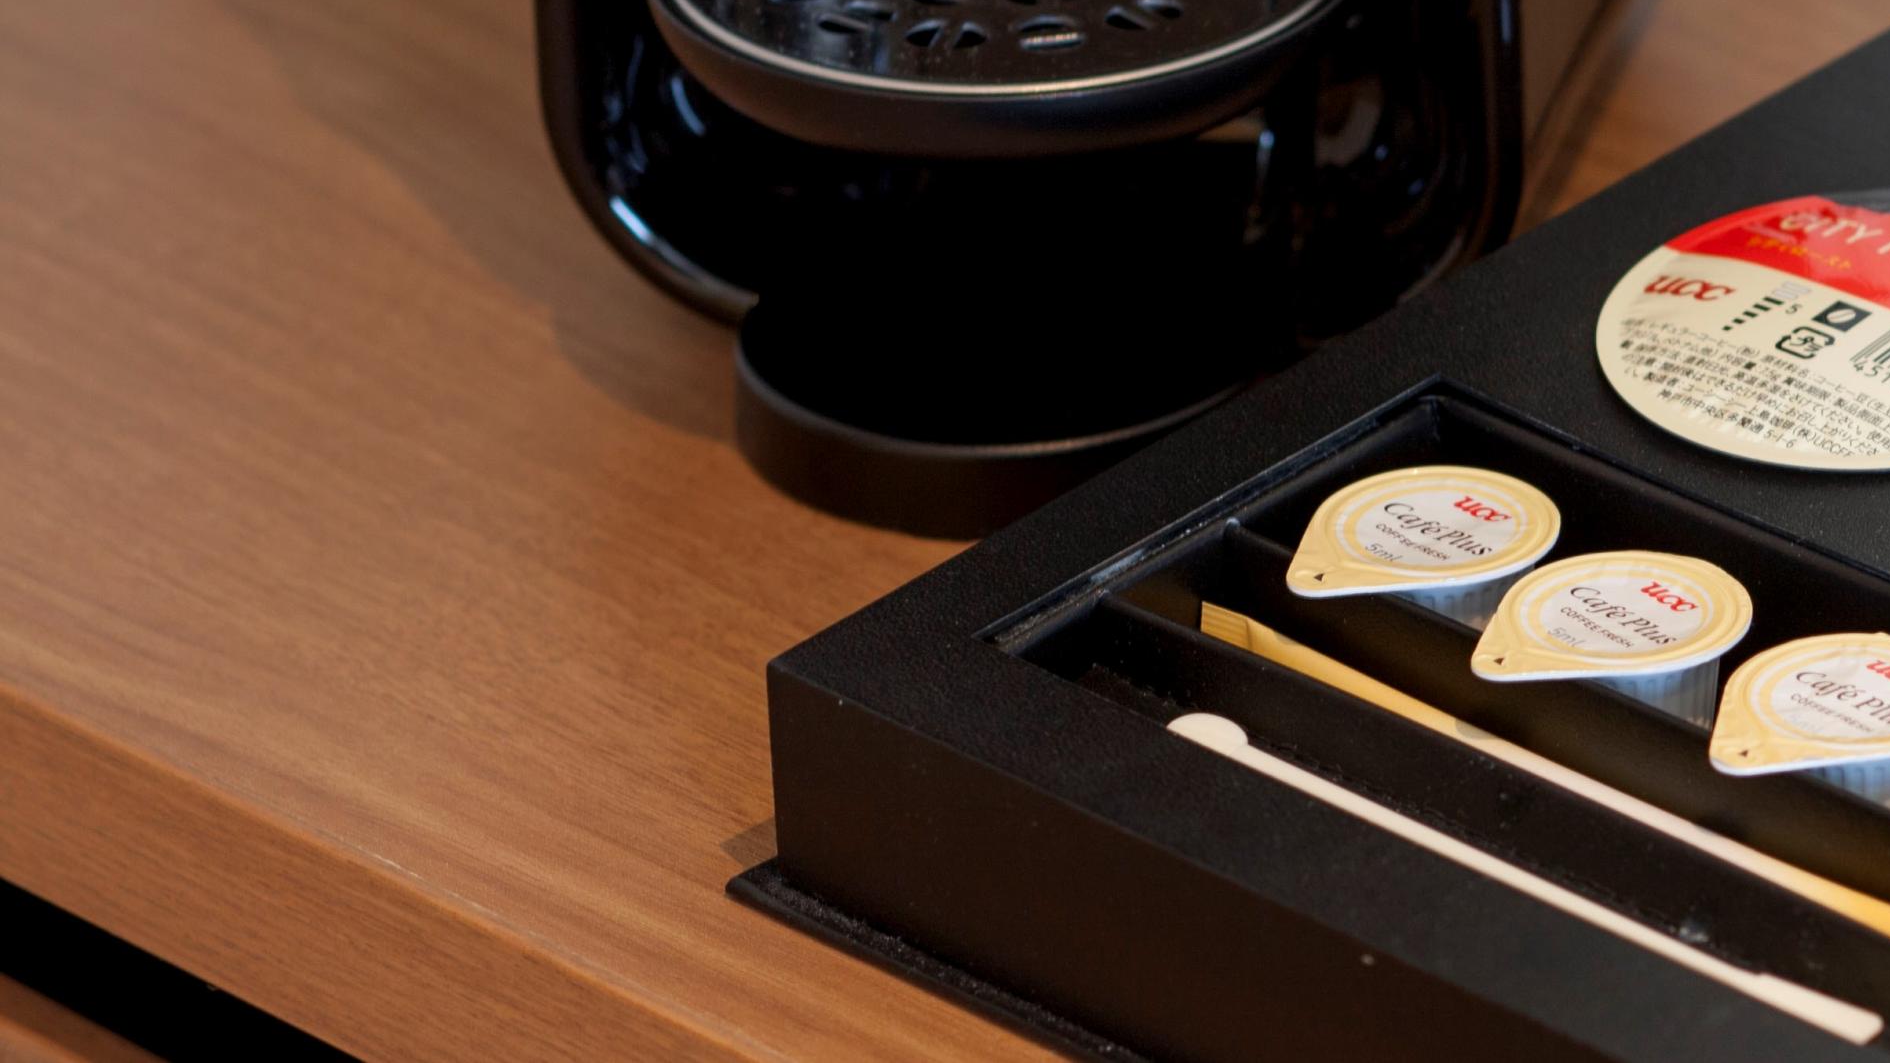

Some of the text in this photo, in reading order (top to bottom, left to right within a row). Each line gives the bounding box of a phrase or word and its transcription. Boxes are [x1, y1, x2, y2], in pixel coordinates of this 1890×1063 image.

[1779, 213, 1883, 246] CITY
[1453, 495, 1512, 523] ucc
[1384, 502, 1493, 558] Café Plus
[1639, 580, 1699, 615] ucc
[1570, 585, 1679, 647] Café Plus
[1795, 669, 1861, 703] Café
